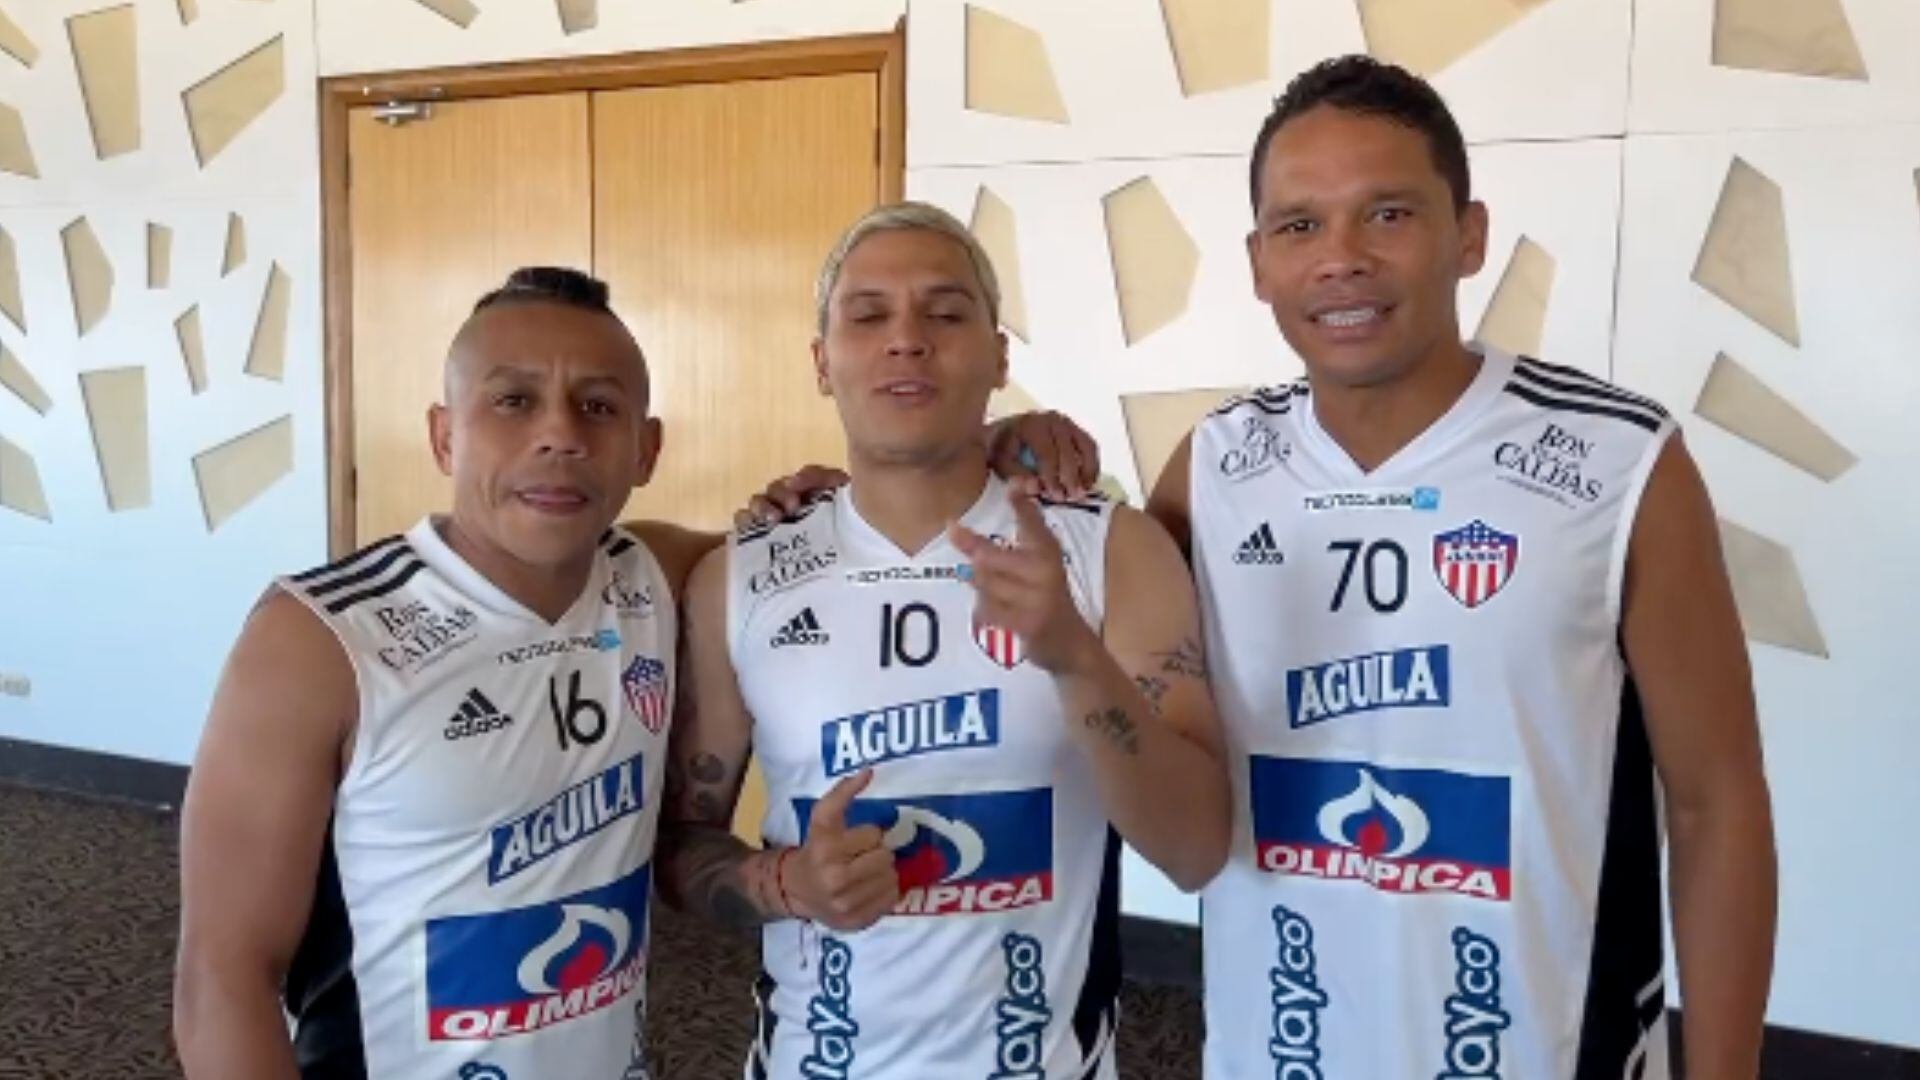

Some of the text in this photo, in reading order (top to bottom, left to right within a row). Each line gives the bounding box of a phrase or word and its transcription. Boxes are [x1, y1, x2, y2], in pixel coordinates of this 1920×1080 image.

[1494, 441, 1602, 502] CALDAS
[1538, 423, 1595, 459] RON
[1231, 549, 1284, 565] adidas
[1327, 538, 1409, 613] 70
[879, 602, 940, 668] 10
[548, 669, 607, 752] 16
[1296, 650, 1440, 724] AGUILA
[832, 690, 989, 772] AGUILA
[498, 761, 638, 878] AGUILA
[893, 875, 1043, 913] MPICA
[1263, 844, 1499, 896] OLIMPICA
[442, 952, 646, 1038] OLIMPI
